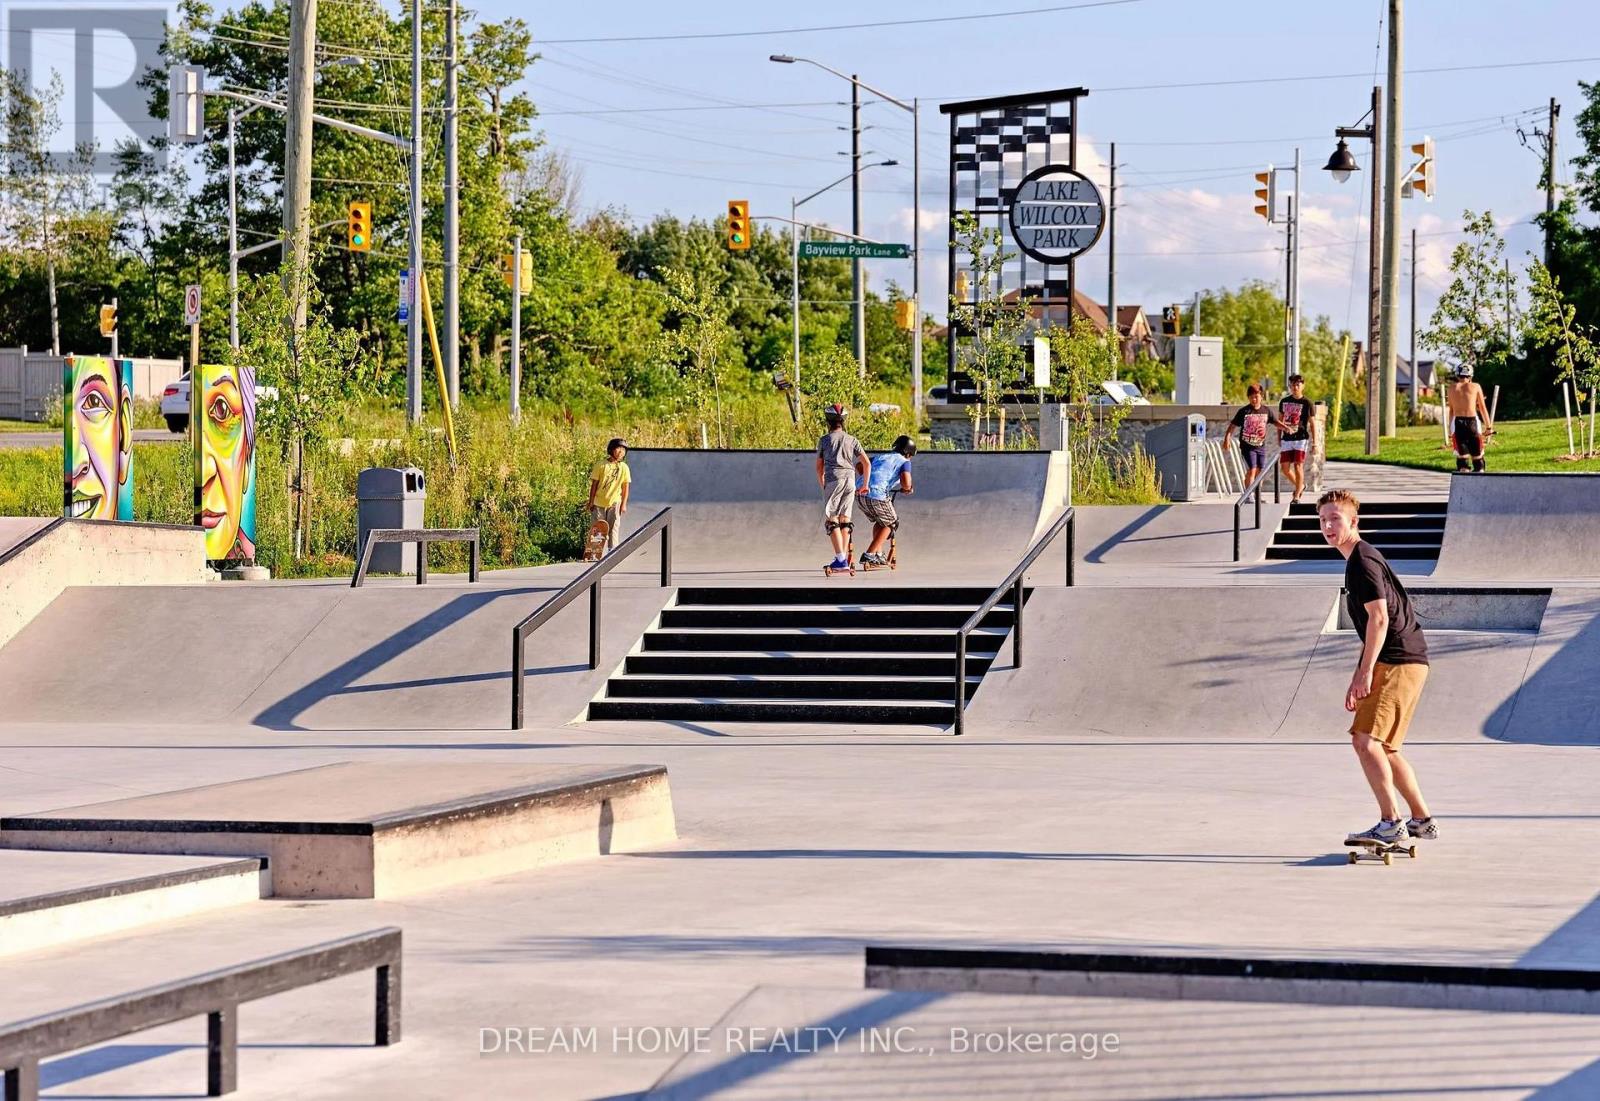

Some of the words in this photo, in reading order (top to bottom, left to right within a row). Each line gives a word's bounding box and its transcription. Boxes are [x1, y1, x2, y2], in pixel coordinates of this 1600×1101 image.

[1033, 181, 1080, 201] LAKE
[1020, 205, 1090, 225] WILCOX
[1032, 228, 1080, 248] PARK
[805, 244, 846, 257] Bayview
[848, 245, 872, 255] Park
